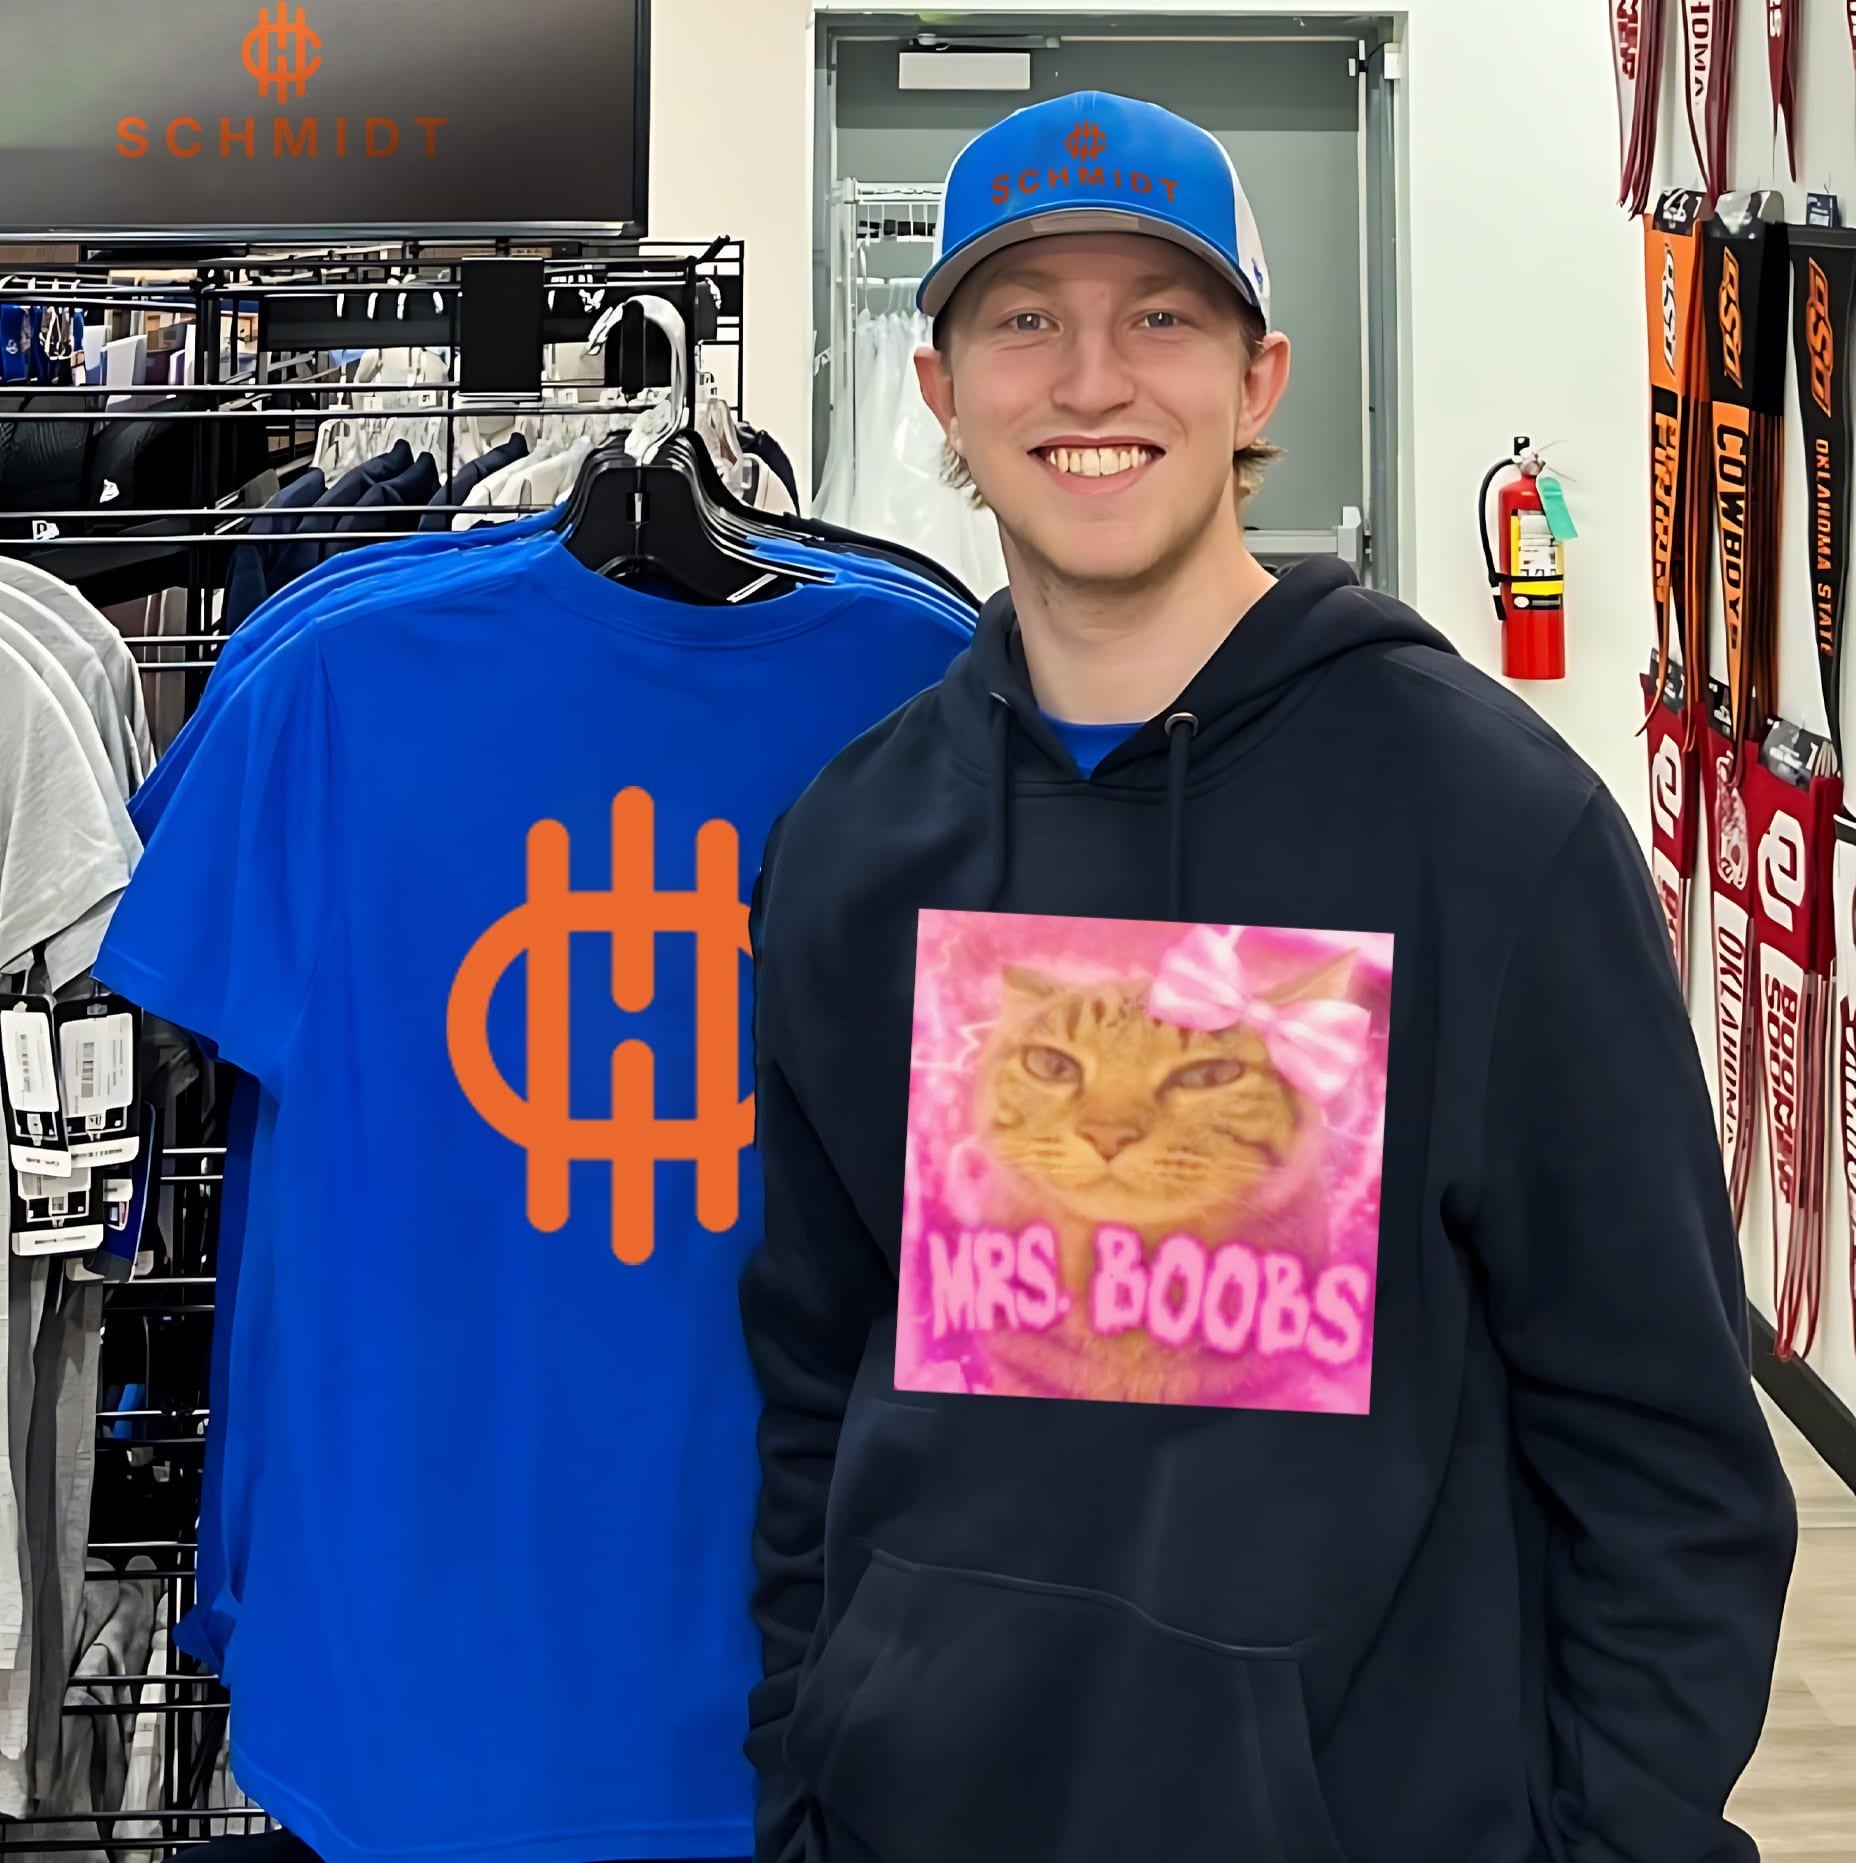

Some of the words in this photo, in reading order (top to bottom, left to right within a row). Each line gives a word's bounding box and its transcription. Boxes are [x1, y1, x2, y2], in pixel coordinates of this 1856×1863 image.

[115, 116, 447, 159] SCHMIDT
[991, 166, 1190, 204] SCHMIDT
[927, 1223, 1070, 1340] MRS.
[1093, 1226, 1369, 1365] BOOBS
